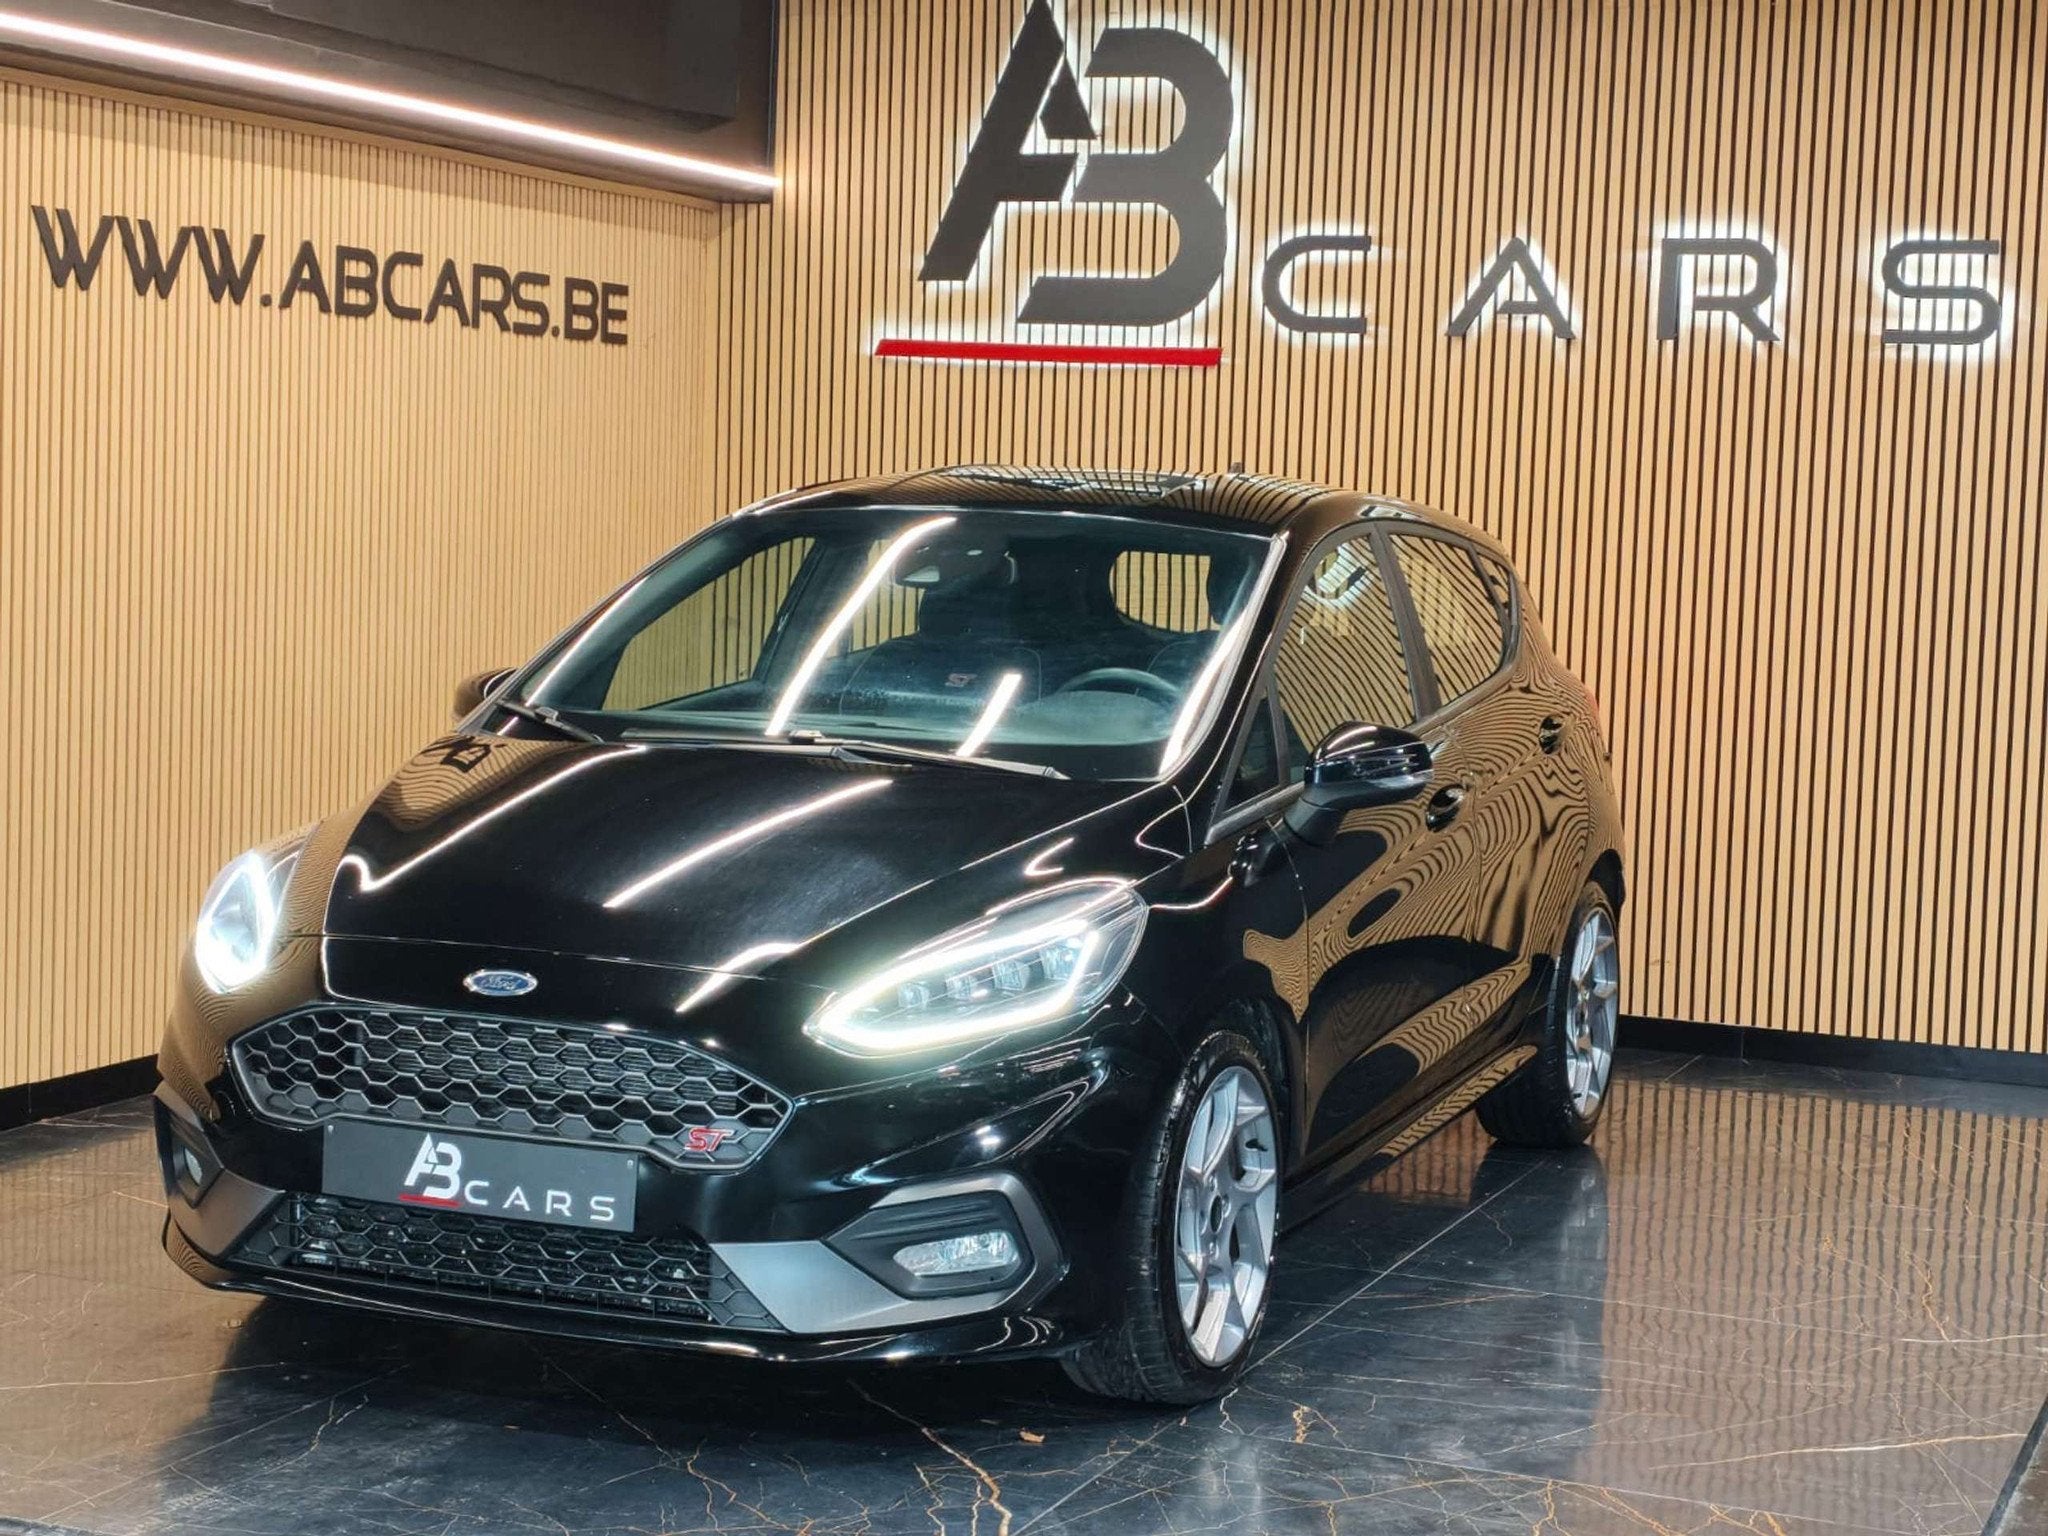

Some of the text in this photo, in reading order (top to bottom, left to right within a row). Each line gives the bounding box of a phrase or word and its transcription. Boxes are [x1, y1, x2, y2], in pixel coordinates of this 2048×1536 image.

[31, 204, 629, 345] WWW.ABCARS.BE
[1262, 235, 2000, 345] CARS
[684, 1127, 735, 1152] ST
[464, 1180, 615, 1222] CARS
